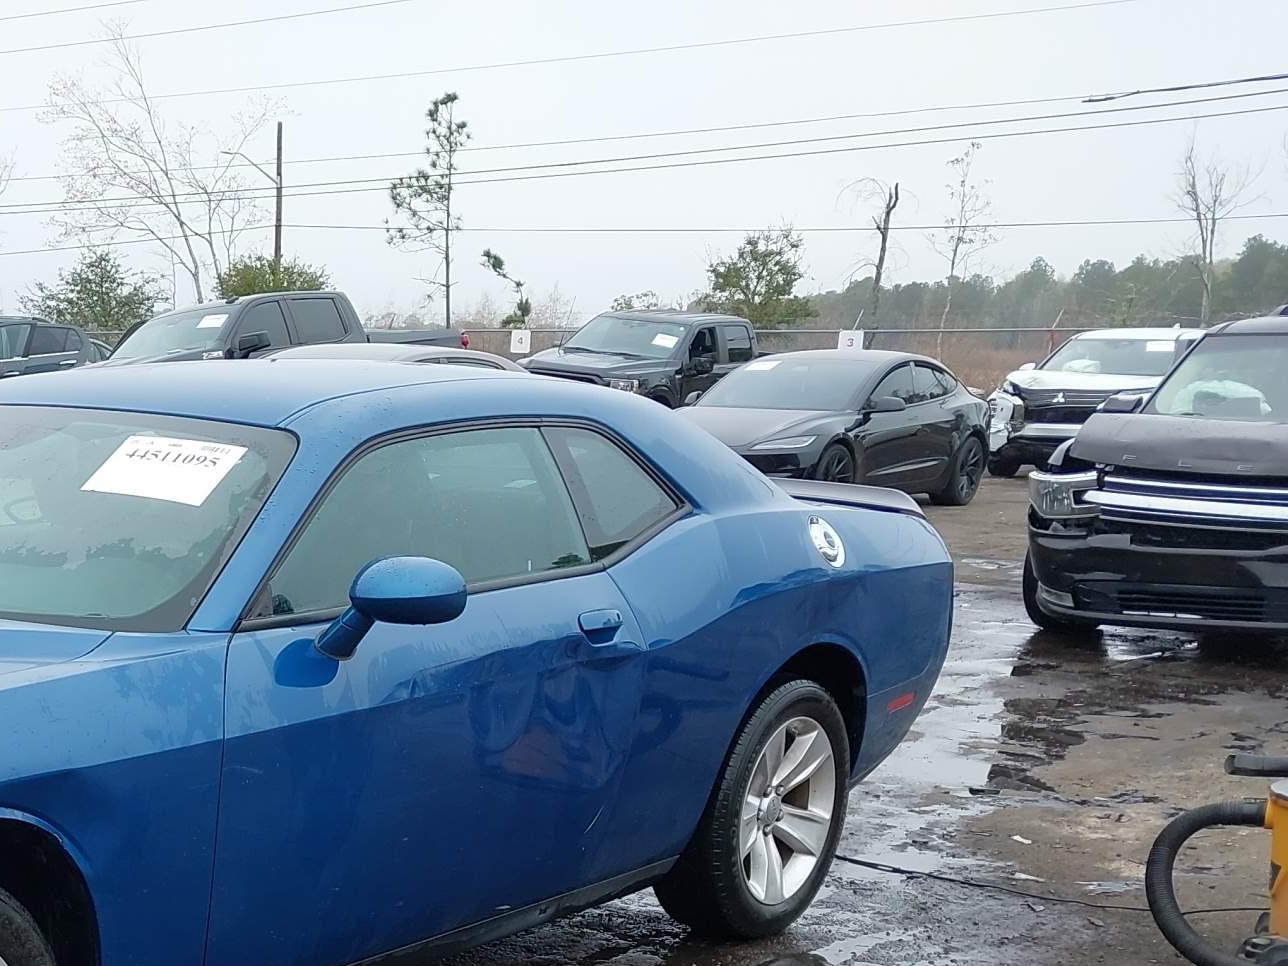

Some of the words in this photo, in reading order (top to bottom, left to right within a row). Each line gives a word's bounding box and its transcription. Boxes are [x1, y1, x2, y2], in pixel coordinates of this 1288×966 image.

[517, 336, 523, 345] 4
[847, 338, 854, 347] 3
[125, 448, 220, 467] 44511095
